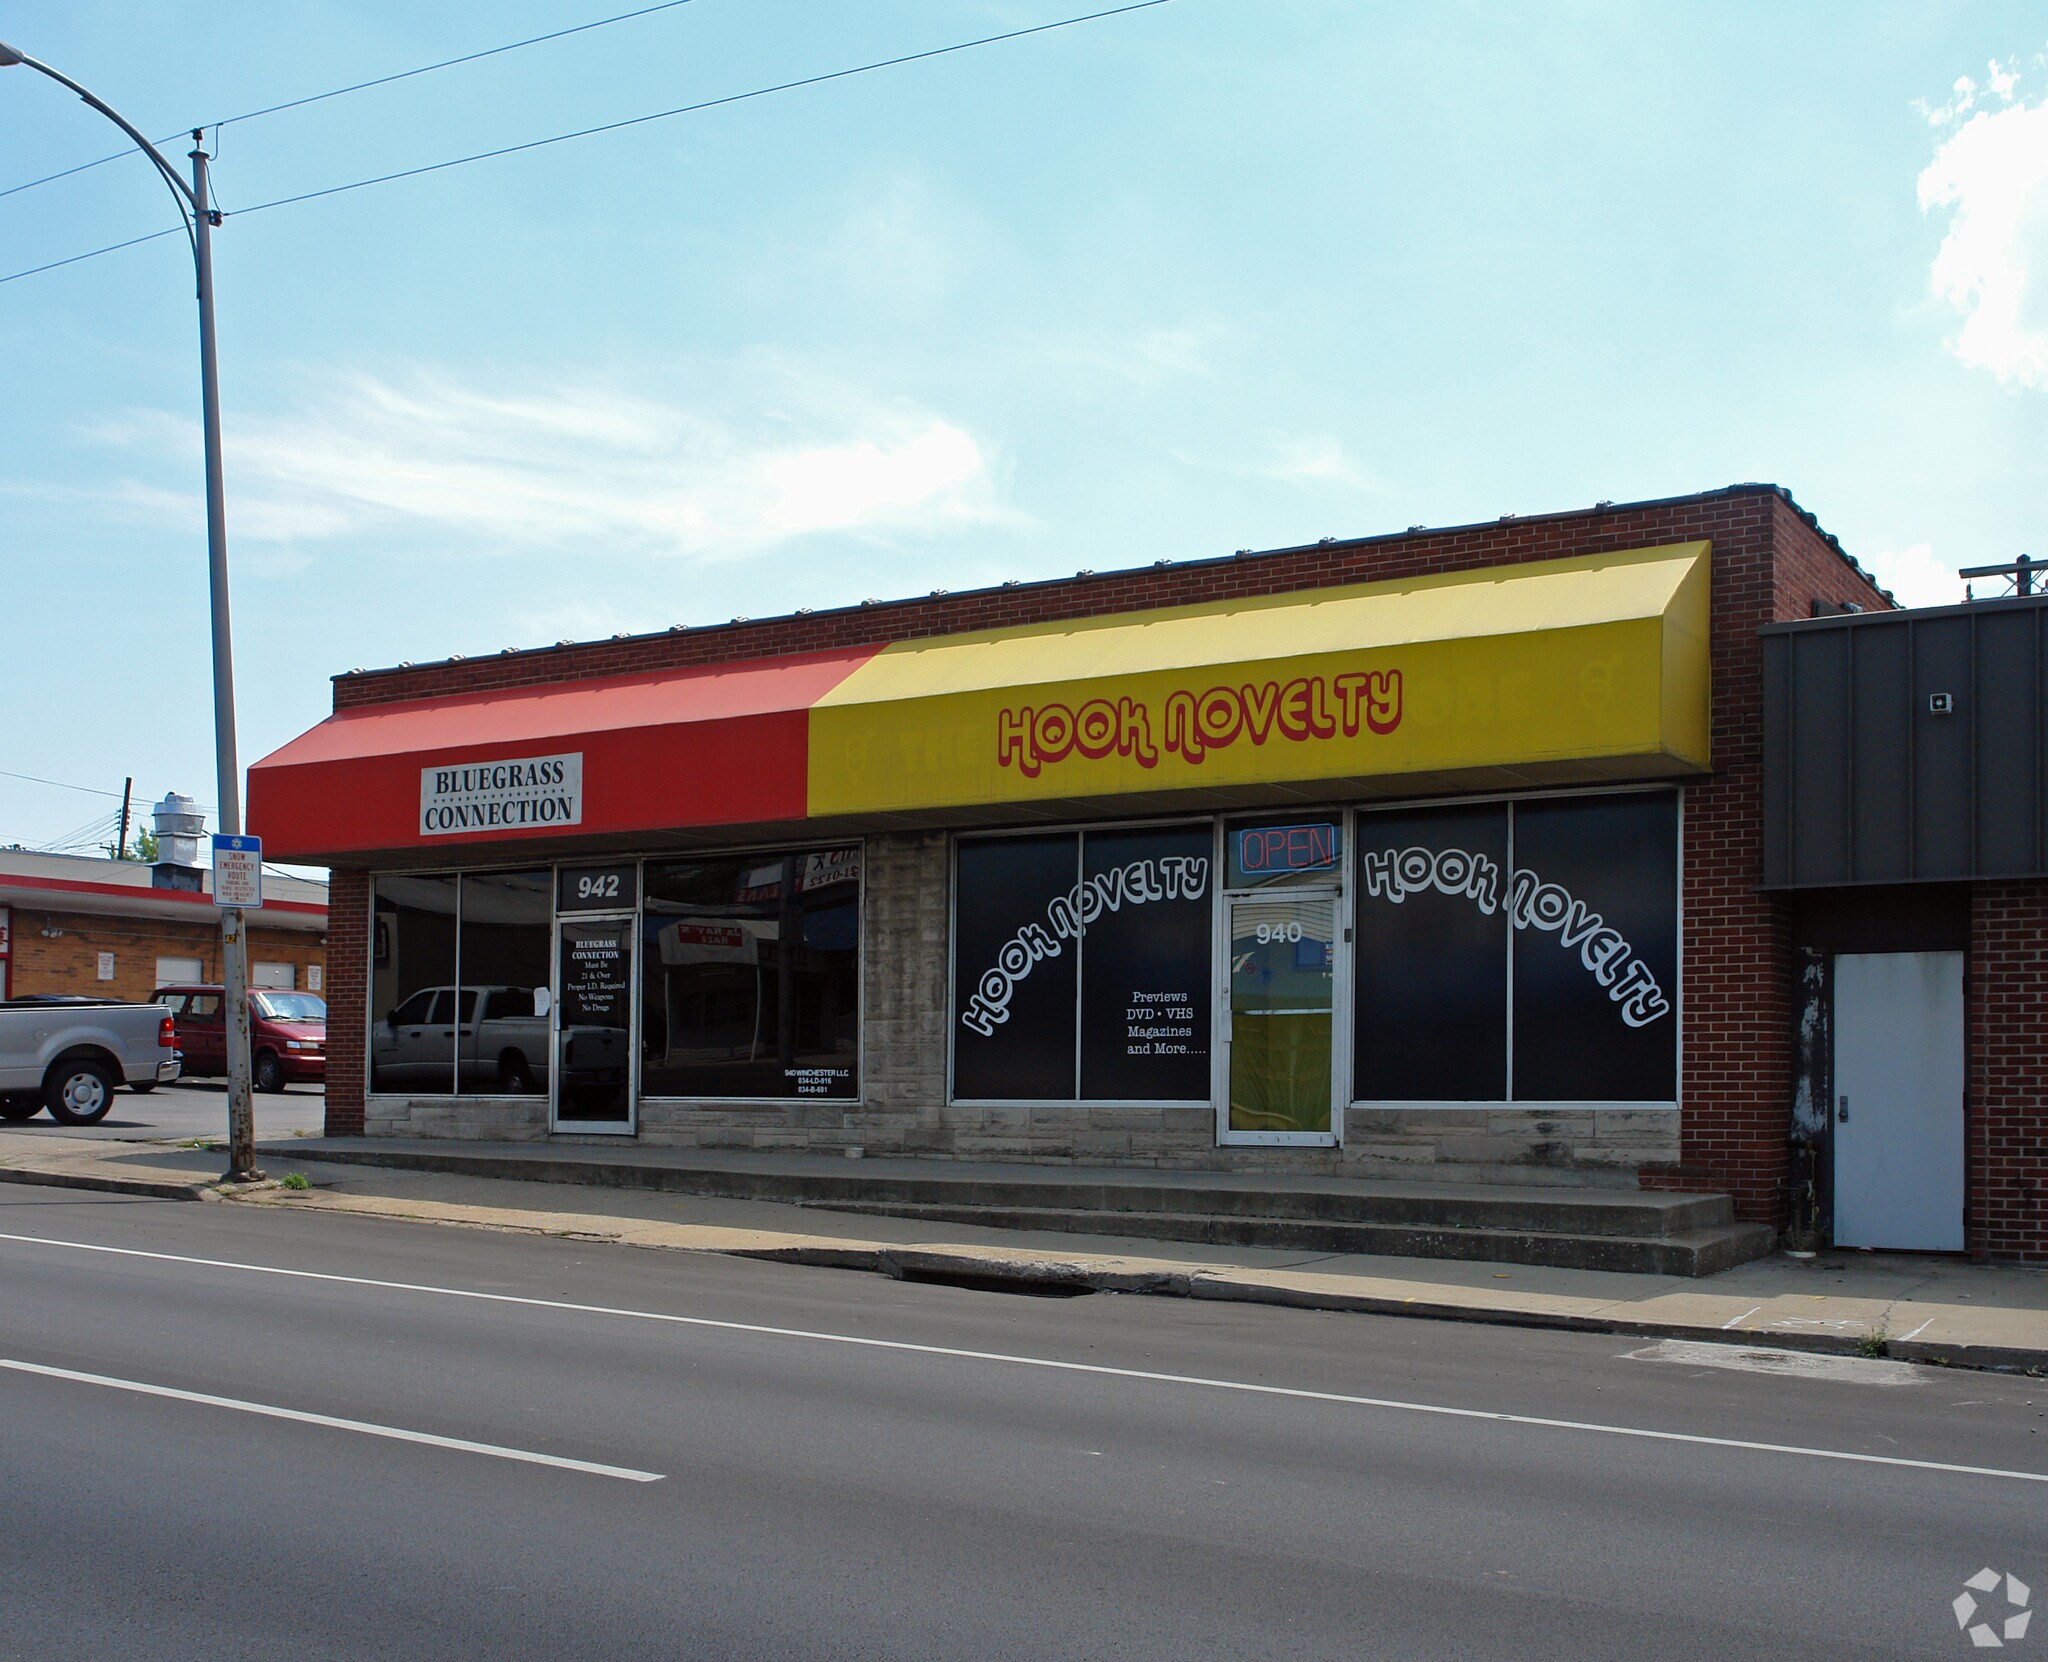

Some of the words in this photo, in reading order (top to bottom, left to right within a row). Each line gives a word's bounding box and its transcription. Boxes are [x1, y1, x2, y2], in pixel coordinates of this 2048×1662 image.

[998, 696, 1158, 778] HOOK
[1165, 669, 1403, 765] NOVELTY
[435, 760, 564, 794] BLUEGRASS
[425, 796, 573, 830] CONNECTION
[1243, 828, 1332, 868] OPEN
[229, 852, 246, 860] SNOW
[220, 861, 255, 871] EMERGENCY
[228, 871, 247, 880] ROUTE
[578, 875, 620, 898] 942
[1256, 921, 1302, 944] 940
[1364, 846, 1498, 915] HOOK
[1502, 869, 1670, 1028] NOVELTY
[575, 940, 617, 949] BLUEGRASS
[962, 923, 1062, 1037] HOOK
[1047, 857, 1208, 939] NOVELTY
[572, 950, 619, 960] CONNECTION
[585, 961, 599, 969] Must
[600, 961, 608, 969] Be
[597, 971, 611, 979] Over
[567, 983, 586, 991] Proper
[600, 981, 626, 991] Required
[578, 994, 588, 1002] No
[588, 993, 614, 1002] Weapons
[1132, 991, 1187, 1002] Previews
[582, 1004, 592, 1012] No
[592, 1003, 610, 1012] Drugs
[1126, 1008, 1154, 1020] DVD
[1165, 1007, 1194, 1019] VHS
[1127, 1025, 1192, 1039] Magazines
[1127, 1043, 1151, 1054] and
[836, 1069, 849, 1077] LLC
